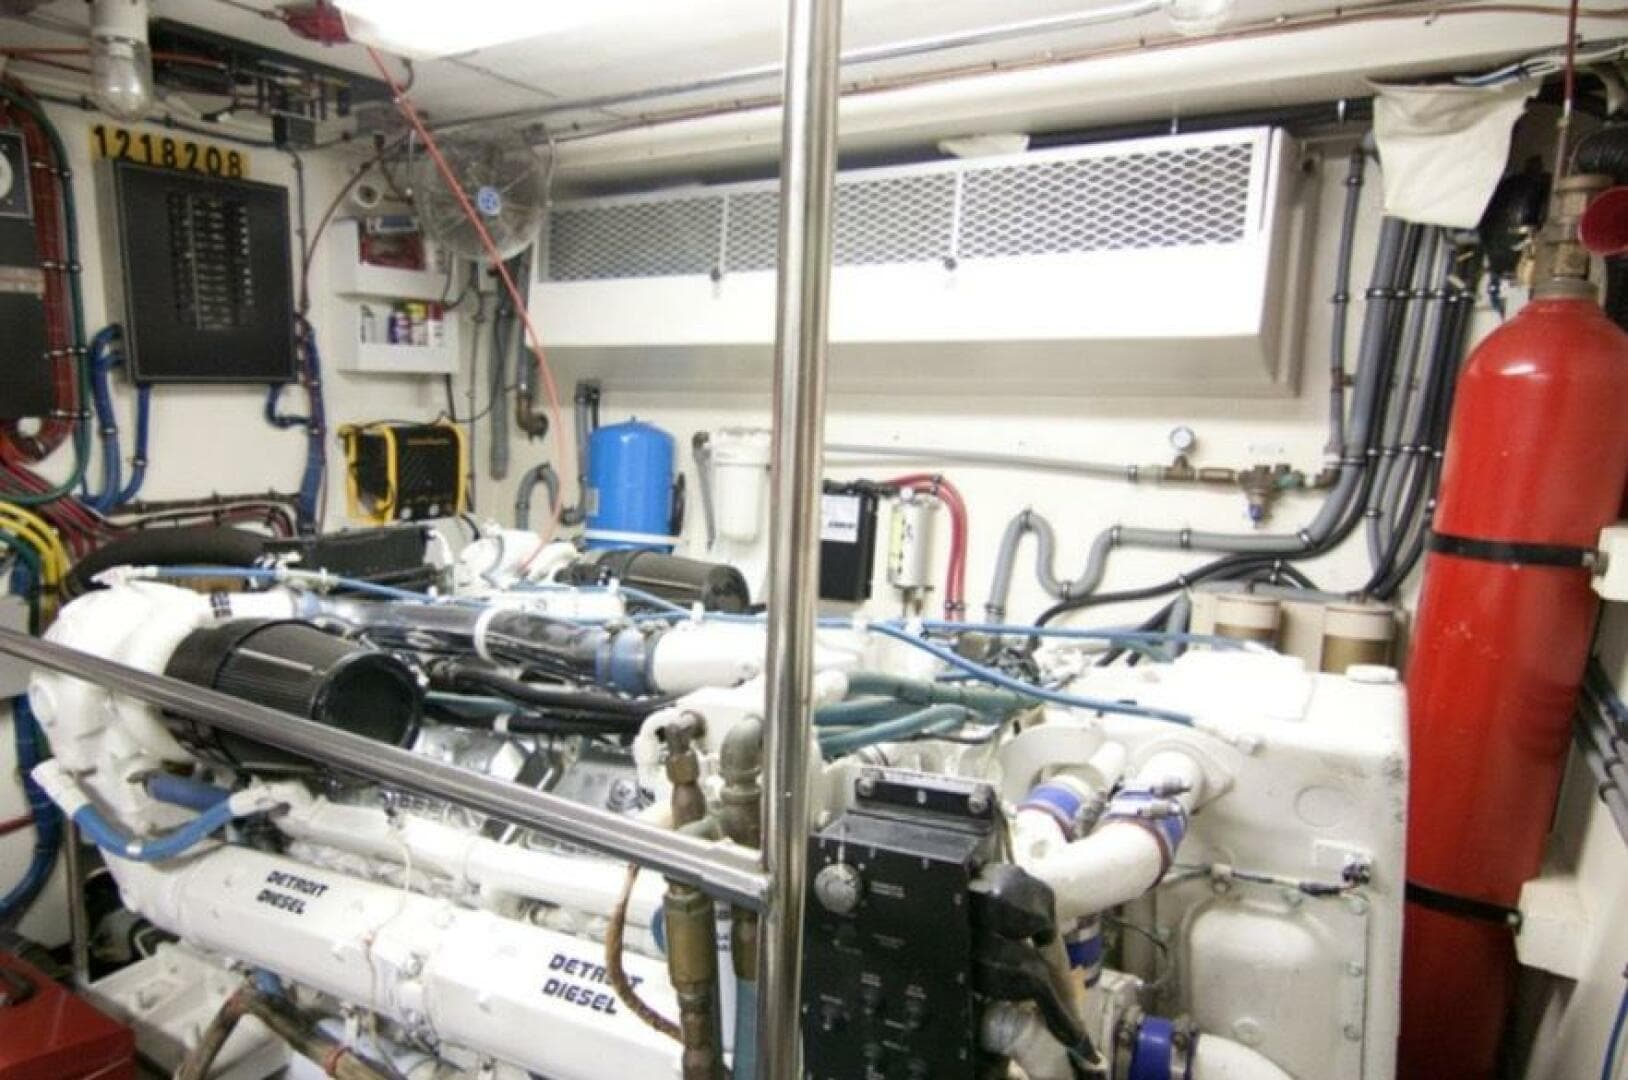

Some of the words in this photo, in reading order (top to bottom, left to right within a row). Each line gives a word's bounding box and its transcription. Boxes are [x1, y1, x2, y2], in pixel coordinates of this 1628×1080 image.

[94, 124, 242, 179] 1218208
[267, 870, 328, 897] DETROIT
[257, 888, 305, 914] DIESEL
[549, 953, 643, 985] DETRT
[543, 978, 616, 1014] DIESEL
